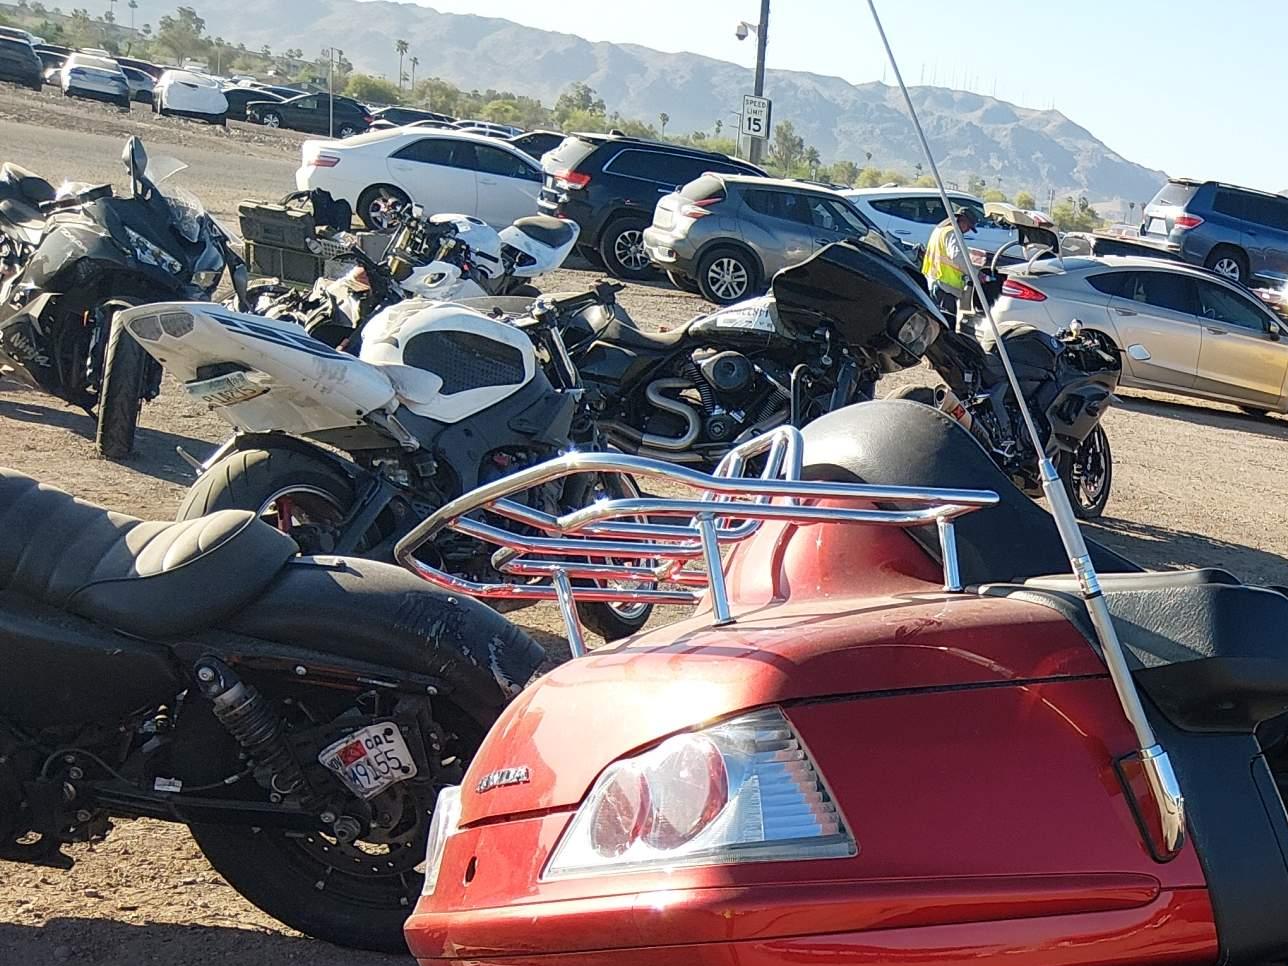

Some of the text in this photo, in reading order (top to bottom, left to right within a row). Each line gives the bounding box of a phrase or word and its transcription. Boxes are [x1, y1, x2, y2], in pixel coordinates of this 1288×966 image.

[745, 99, 767, 108] SPEED
[747, 116, 762, 132] 15
[10, 331, 51, 368] Ninja
